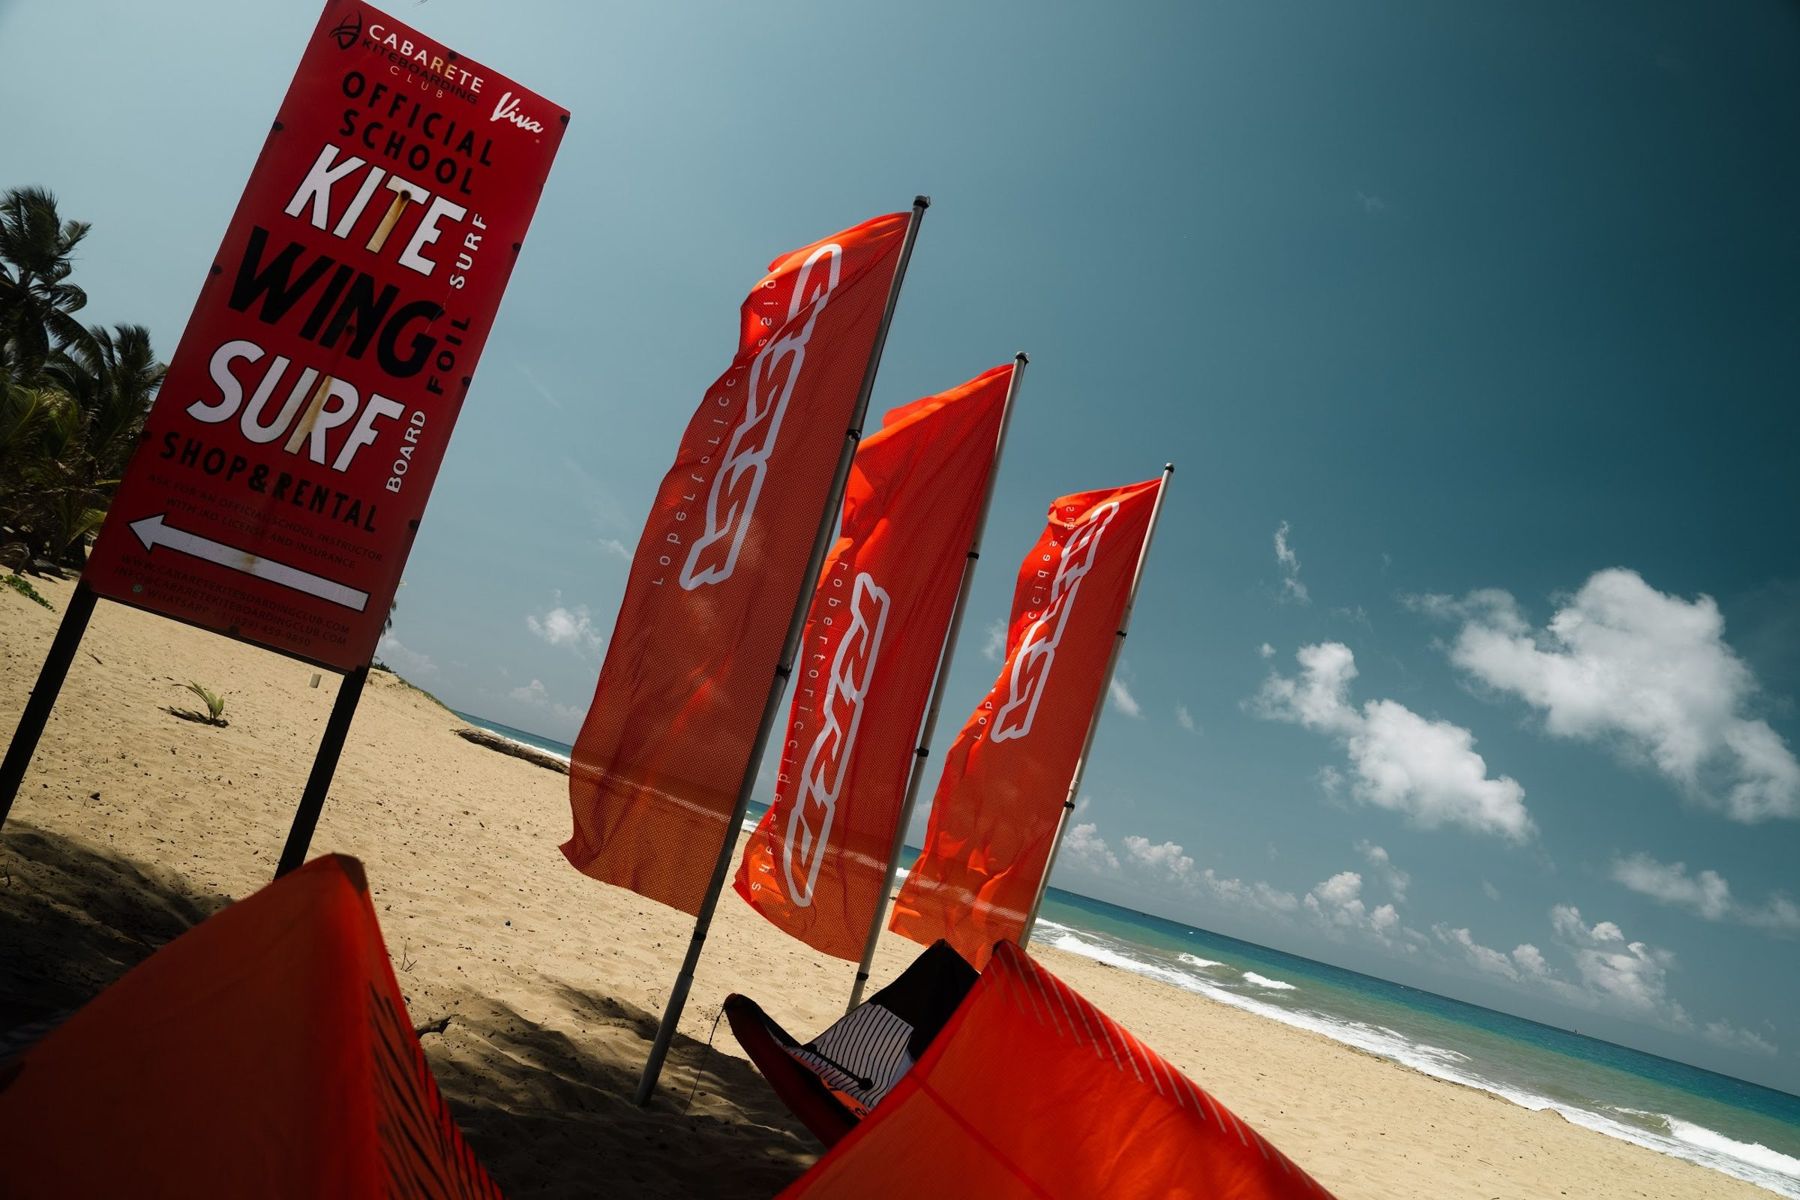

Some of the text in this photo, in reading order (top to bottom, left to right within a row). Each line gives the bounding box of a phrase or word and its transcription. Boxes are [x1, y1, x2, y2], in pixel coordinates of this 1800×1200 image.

[361, 39, 478, 105] KITEBOARDING
[369, 24, 484, 93] CABARETE
[390, 65, 443, 98] CLUB
[338, 108, 473, 195] SCHOOL
[342, 71, 493, 167] OFFICIAL
[490, 92, 543, 133] Viva
[284, 143, 468, 277] KITE
[449, 213, 488, 289] SURF
[227, 224, 446, 379] WING
[426, 316, 471, 396] FOIL
[186, 338, 406, 473] SURF
[159, 431, 378, 533] SHOP&RENTAL
[385, 409, 427, 494] BOARD
